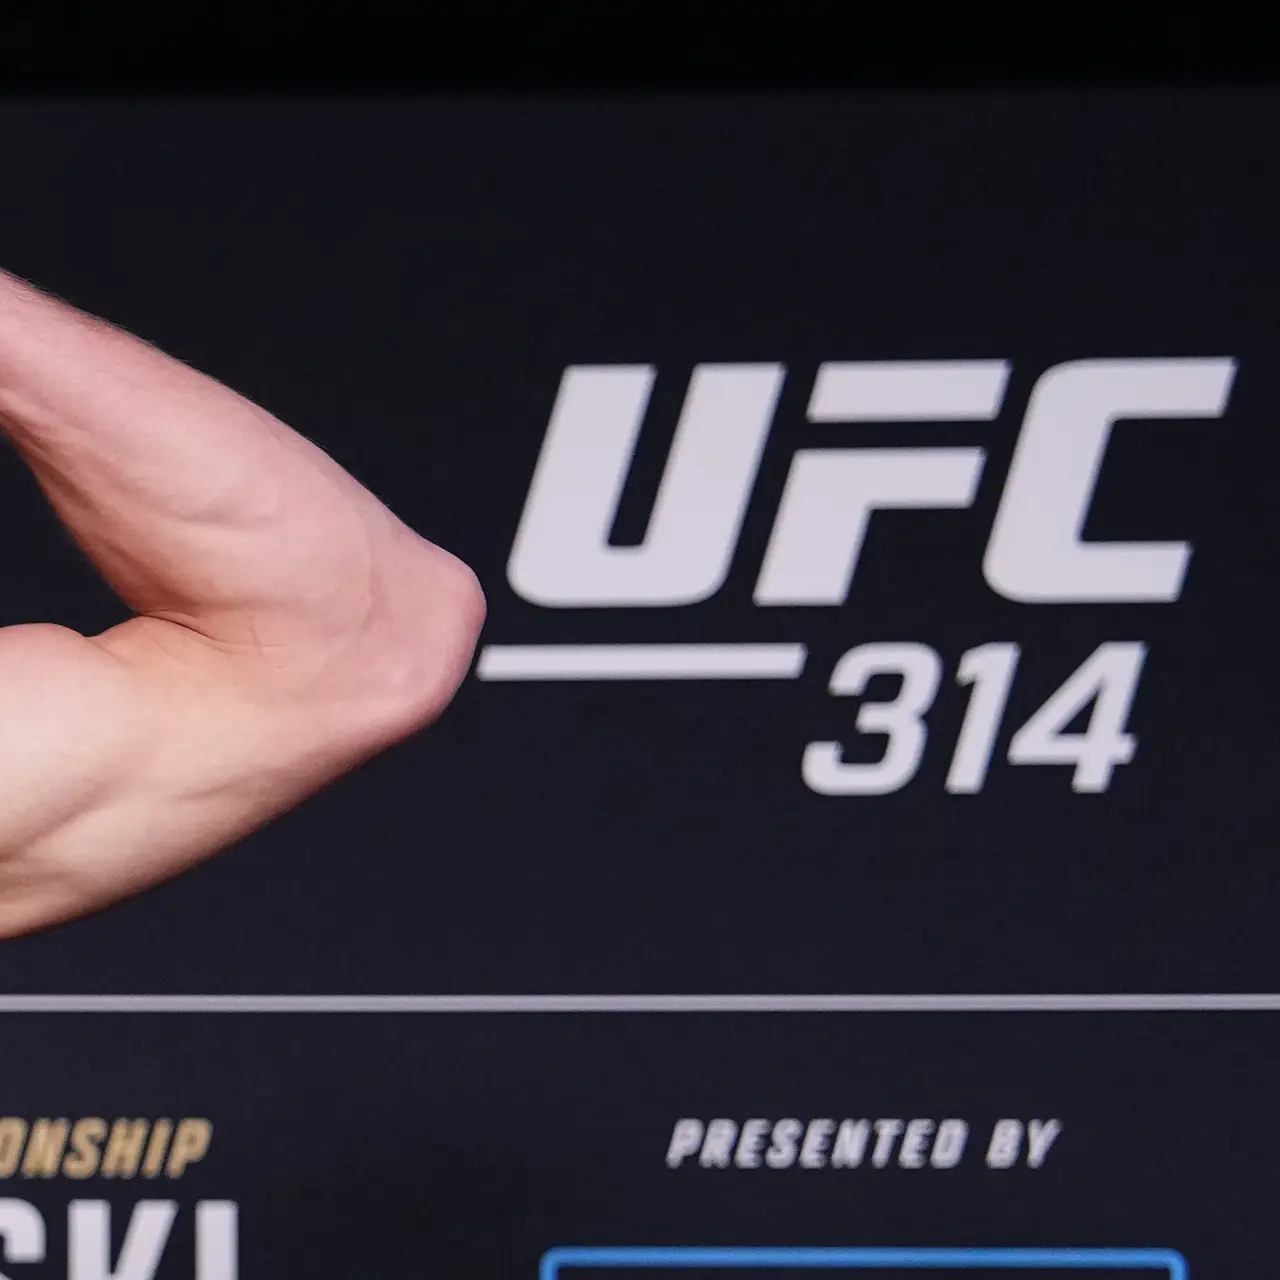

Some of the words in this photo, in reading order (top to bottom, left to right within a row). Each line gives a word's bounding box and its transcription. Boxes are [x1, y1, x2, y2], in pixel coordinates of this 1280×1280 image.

[506, 356, 1237, 608] UFC
[801, 640, 1148, 796] 314
[666, 1118, 969, 1169] PRESENTED
[985, 1118, 1062, 1169] BY
